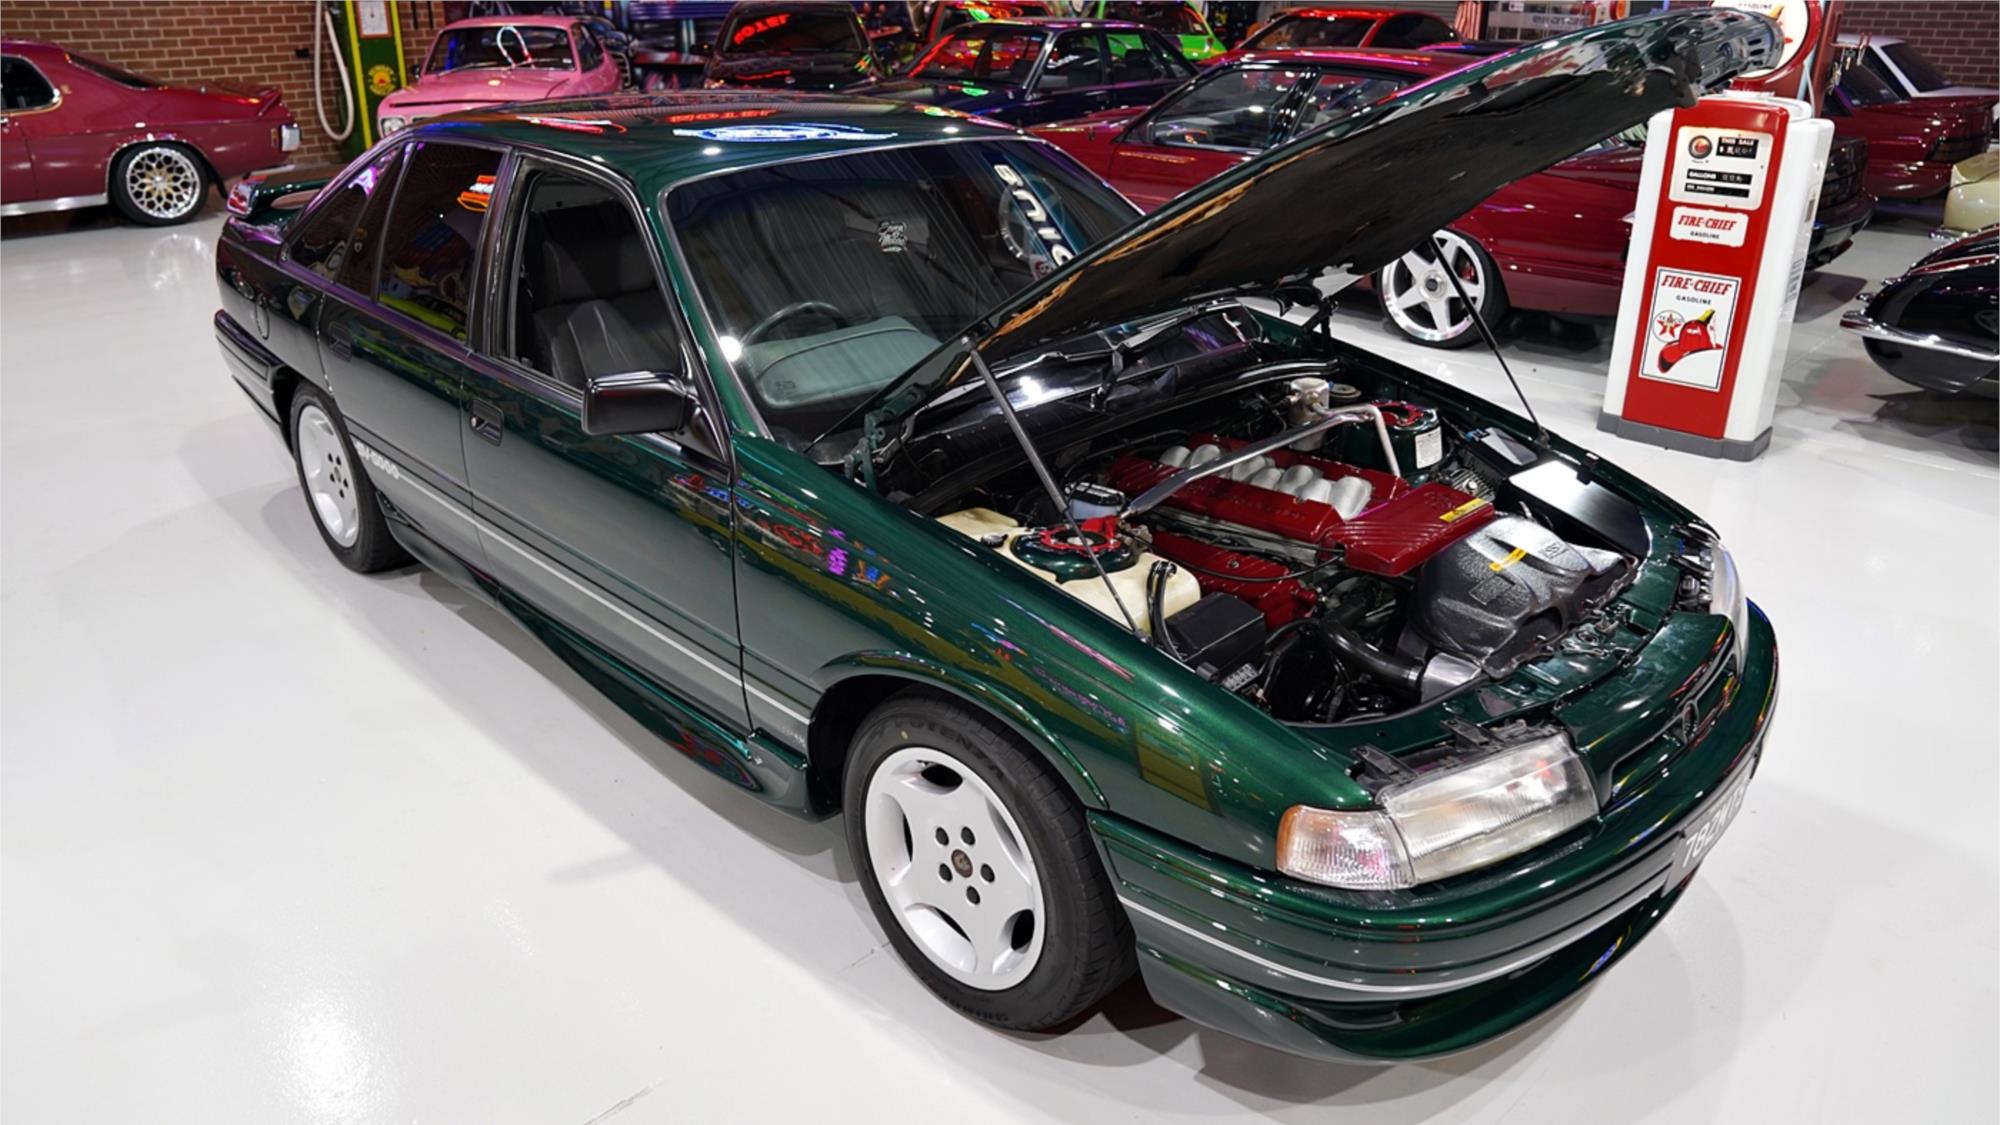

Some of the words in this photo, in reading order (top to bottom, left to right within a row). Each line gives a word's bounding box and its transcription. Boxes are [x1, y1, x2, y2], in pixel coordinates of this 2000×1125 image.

[1678, 215, 1737, 231] FIRE-CHIEF
[1690, 231, 1720, 239] GASOLINE
[1661, 275, 1732, 295] FIRE-CHIEF
[1676, 295, 1712, 305] GASOLINE
